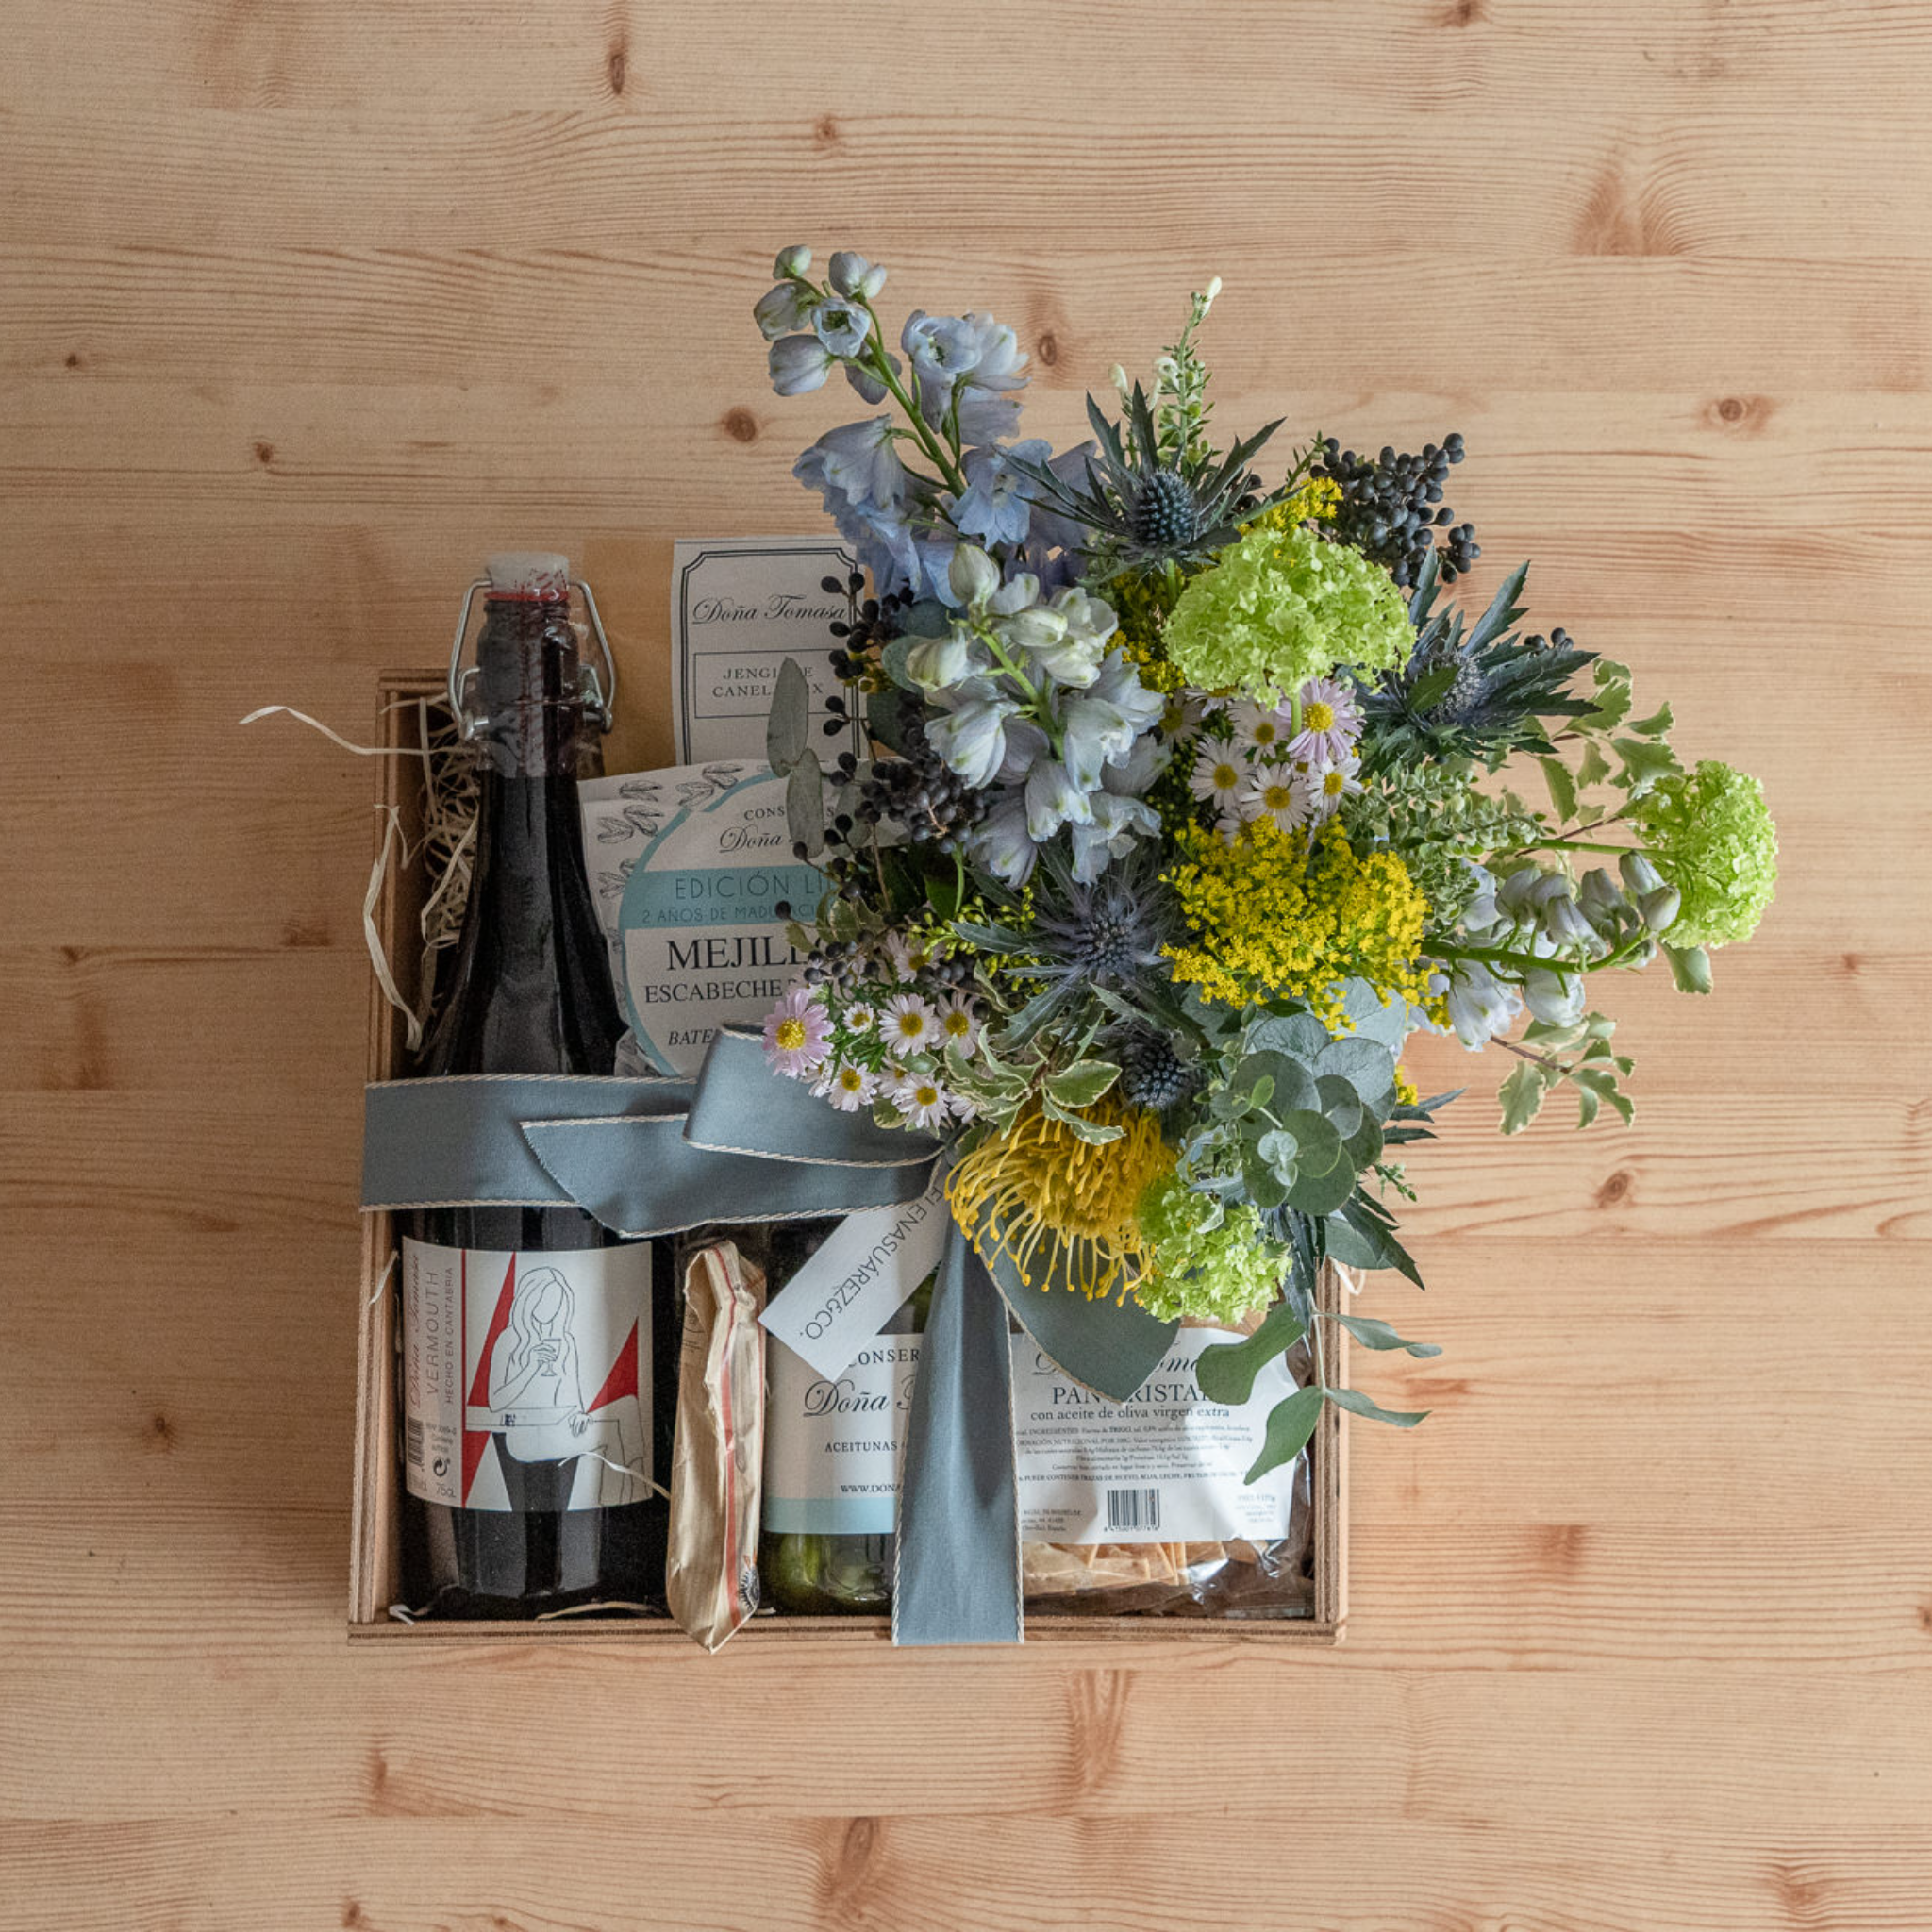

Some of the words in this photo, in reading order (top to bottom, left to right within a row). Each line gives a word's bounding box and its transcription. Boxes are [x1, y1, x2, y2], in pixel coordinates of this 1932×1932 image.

[692, 596, 758, 625] Doña
[764, 593, 846, 620] Tomasa
[723, 666, 814, 680] JENGIE
[712, 685, 772, 698] CANEL
[743, 807, 835, 822] CONSS
[719, 824, 783, 854] Doña
[675, 871, 790, 900] EDICIÓN
[642, 909, 651, 924] 2
[658, 907, 704, 924] AÑOS
[710, 906, 727, 921] DE
[665, 935, 809, 971] MEJILL
[645, 978, 783, 1004] ESCABECHE
[668, 1028, 714, 1046] BATE
[443, 1267, 453, 1336] CANTABRIA
[425, 1271, 440, 1395] VERMOUTH
[444, 1340, 454, 1357] EN
[847, 1348, 920, 1367] ONSER
[444, 1361, 454, 1404] HECHO
[803, 1378, 889, 1417] Doña
[1128, 1383, 1208, 1403] RISTA
[1030, 1409, 1055, 1421] con
[1057, 1407, 1092, 1420] aceite
[1098, 1406, 1114, 1418] de
[1118, 1406, 1150, 1419] oliva
[1153, 1407, 1194, 1422] virgen
[1196, 1407, 1230, 1418] extra
[824, 1441, 898, 1453] ACEITUNAS
[840, 1483, 901, 1492] WWW.DON
